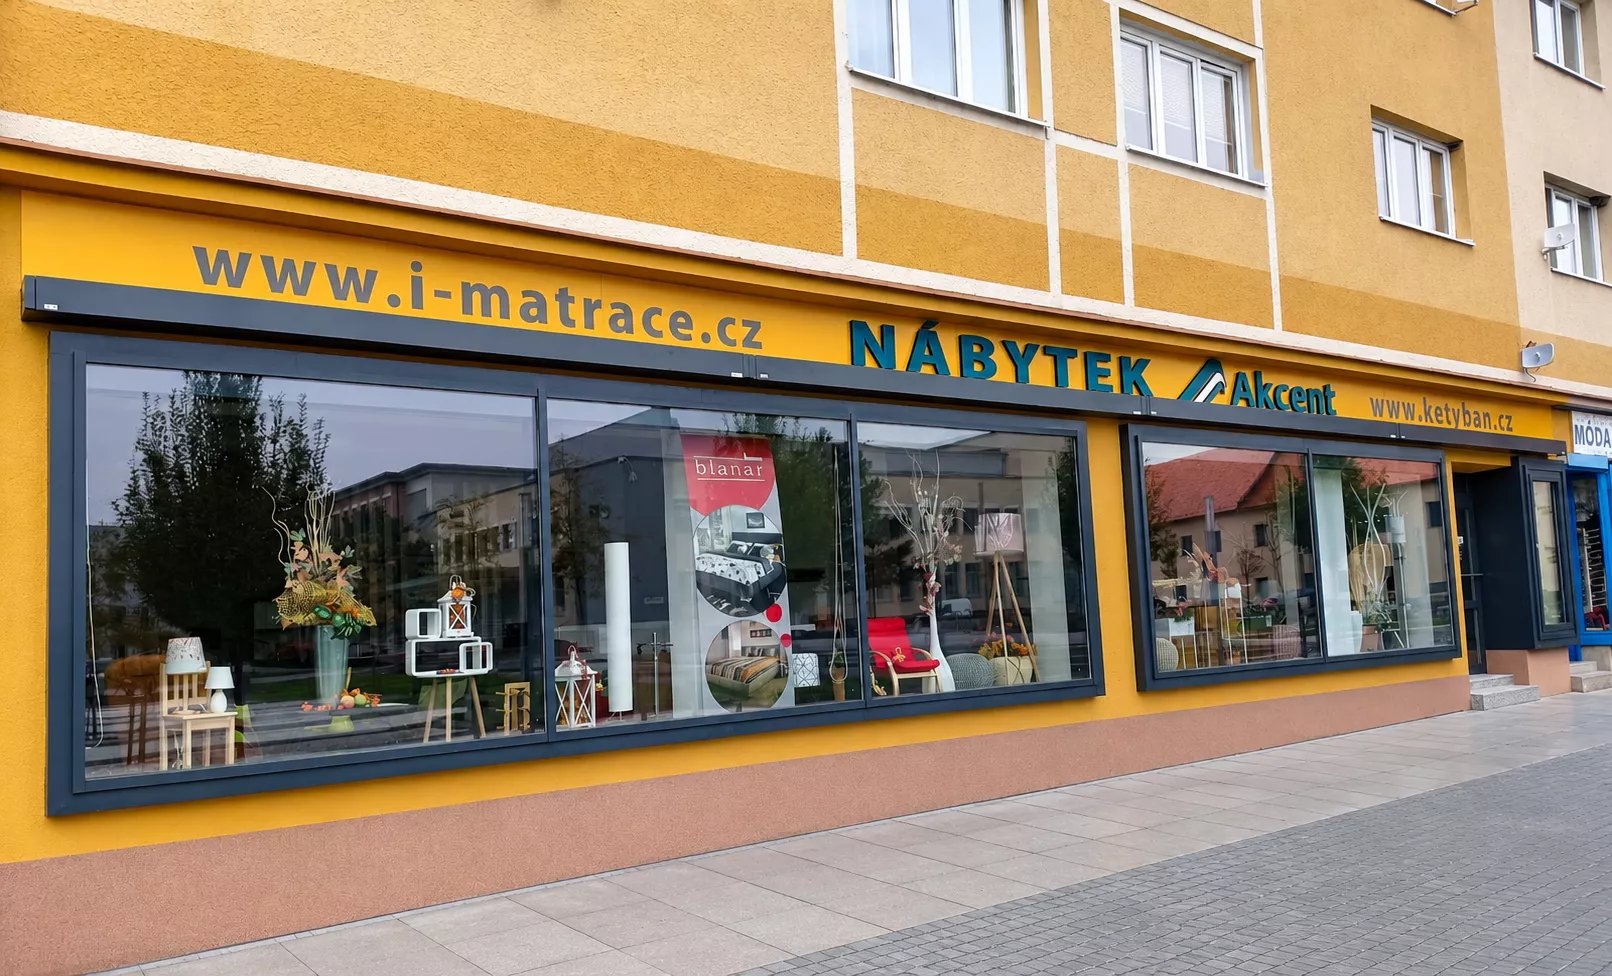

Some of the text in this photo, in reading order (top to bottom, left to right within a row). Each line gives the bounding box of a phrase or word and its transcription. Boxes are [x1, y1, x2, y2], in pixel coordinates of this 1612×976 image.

[192, 245, 763, 350] www.i-matrace.cz
[849, 319, 1154, 397] NÁBYTEK
[1230, 370, 1337, 416] Akcent
[1369, 396, 1513, 432] www.ketyban.cz
[1574, 419, 1612, 448] MÓDA
[694, 459, 763, 477] blanar
